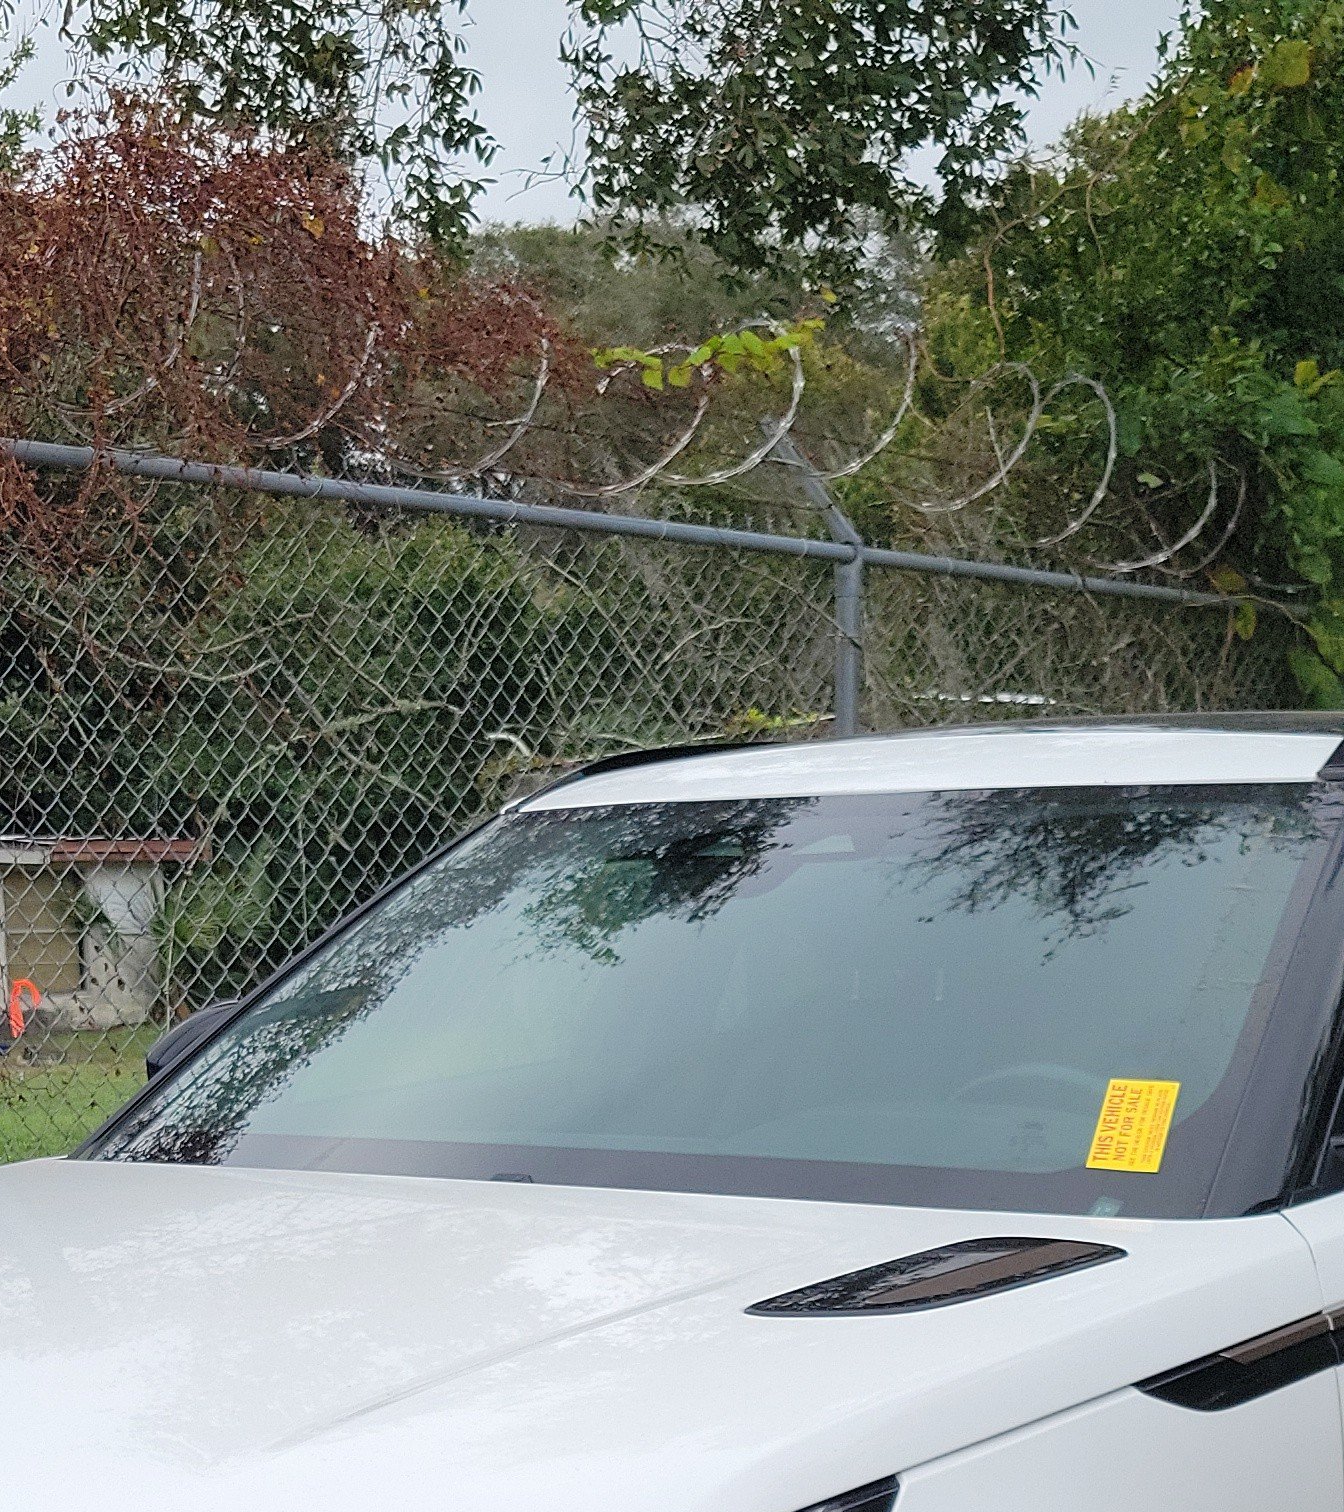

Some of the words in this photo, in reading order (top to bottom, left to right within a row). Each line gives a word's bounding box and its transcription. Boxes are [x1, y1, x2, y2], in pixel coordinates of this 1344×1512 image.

[1100, 1085, 1128, 1132] VEHICLE
[1126, 1088, 1143, 1113] SALE
[1120, 1117, 1134, 1137] FOR
[1093, 1136, 1113, 1162] THIS
[1113, 1141, 1129, 1161] NOT
